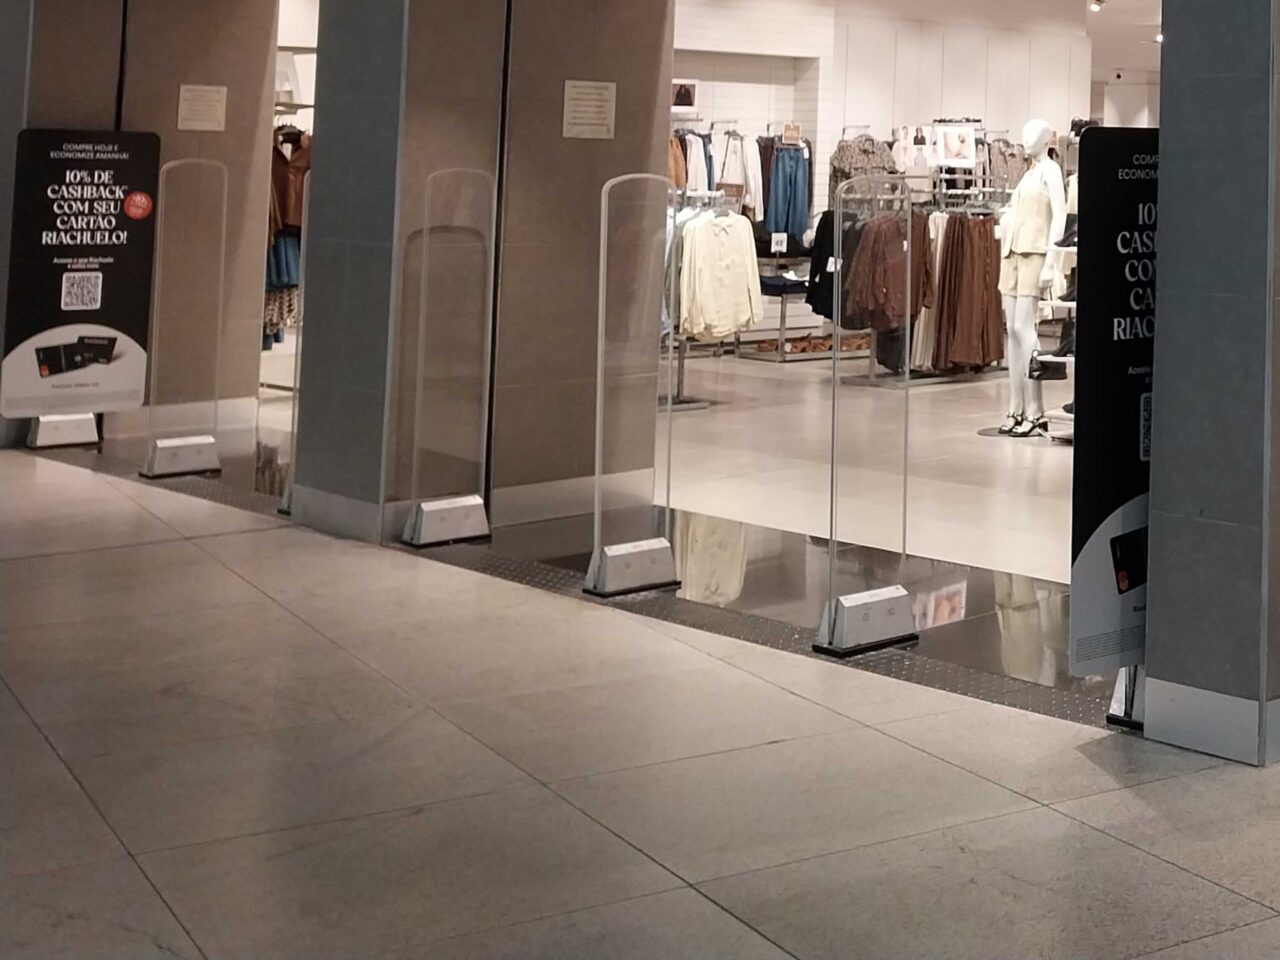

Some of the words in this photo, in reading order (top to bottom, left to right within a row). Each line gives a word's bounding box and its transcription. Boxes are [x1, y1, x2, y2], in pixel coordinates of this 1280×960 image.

[65, 169, 91, 184] 10%
[94, 169, 114, 184] DE
[53, 200, 89, 214] COM
[93, 200, 120, 214] SEU
[56, 214, 116, 230] CARTÃO
[41, 230, 128, 246] RIACHUELO!
